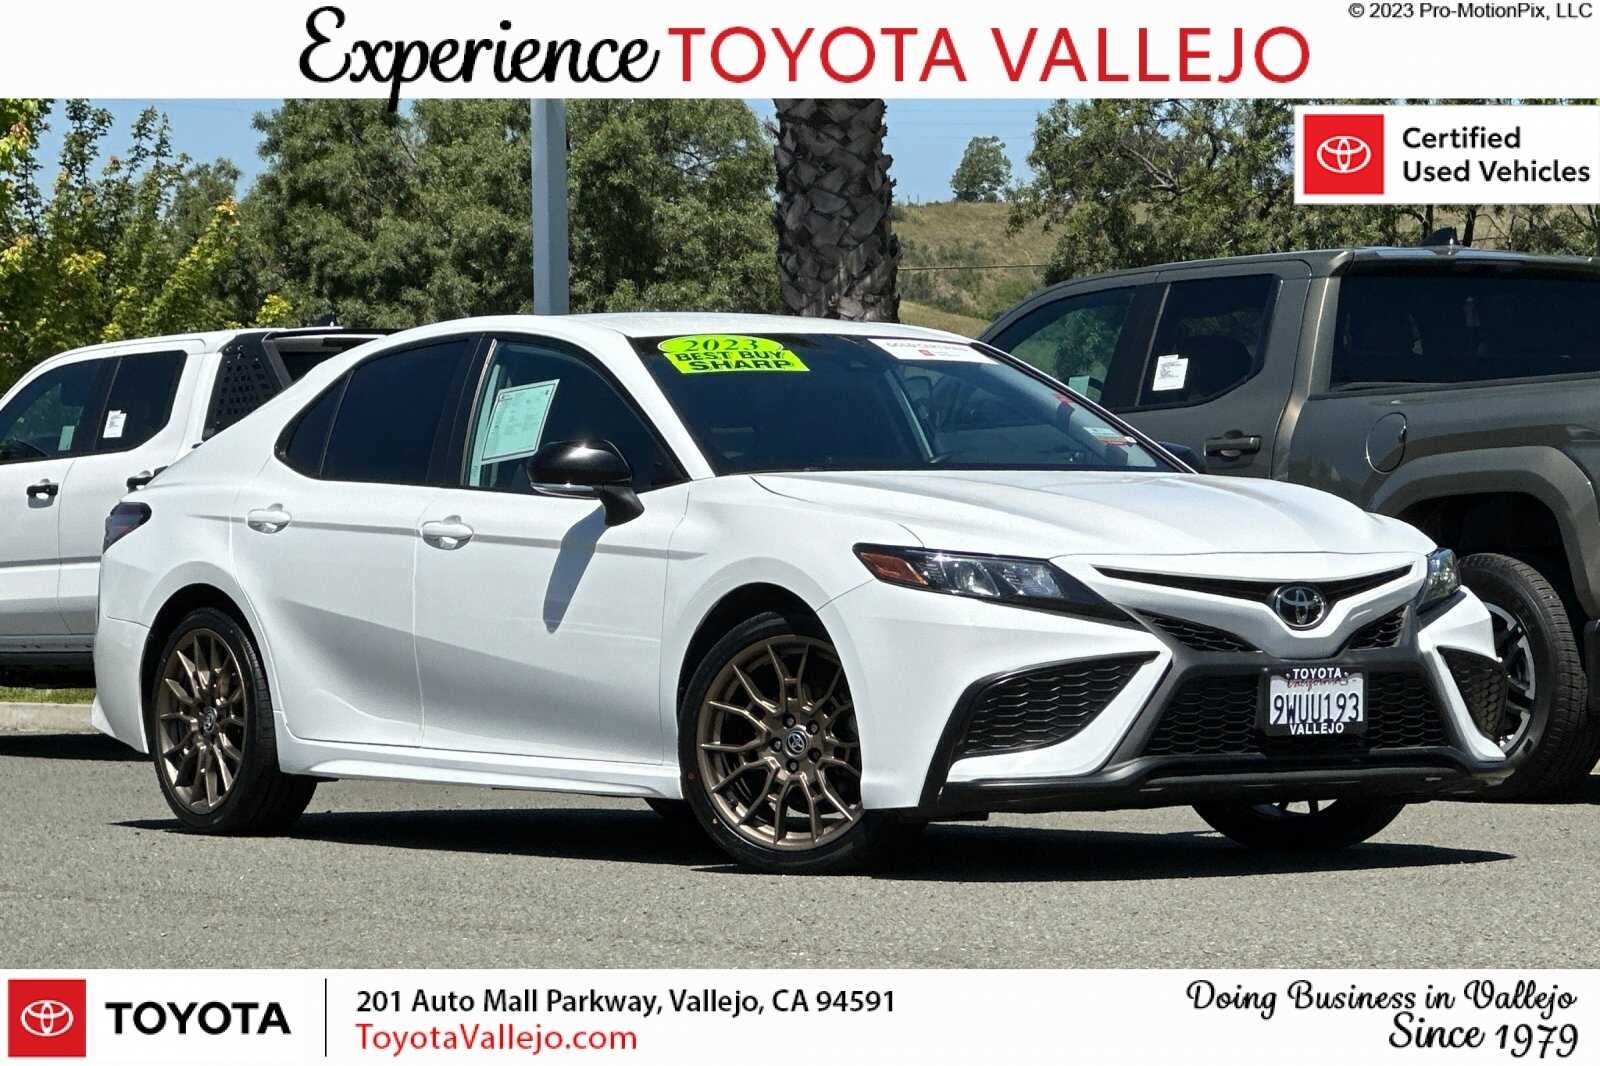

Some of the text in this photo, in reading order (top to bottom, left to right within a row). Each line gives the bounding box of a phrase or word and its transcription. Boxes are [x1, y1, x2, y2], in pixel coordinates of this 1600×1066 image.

[684, 339, 758, 351] 2023
[675, 350, 782, 362] BEST BUY
[688, 359, 791, 371] SHARP
[1292, 667, 1342, 680] TOYOTA
[1273, 692, 1360, 725] 9WUU193
[1289, 721, 1345, 736] VALLEJO
